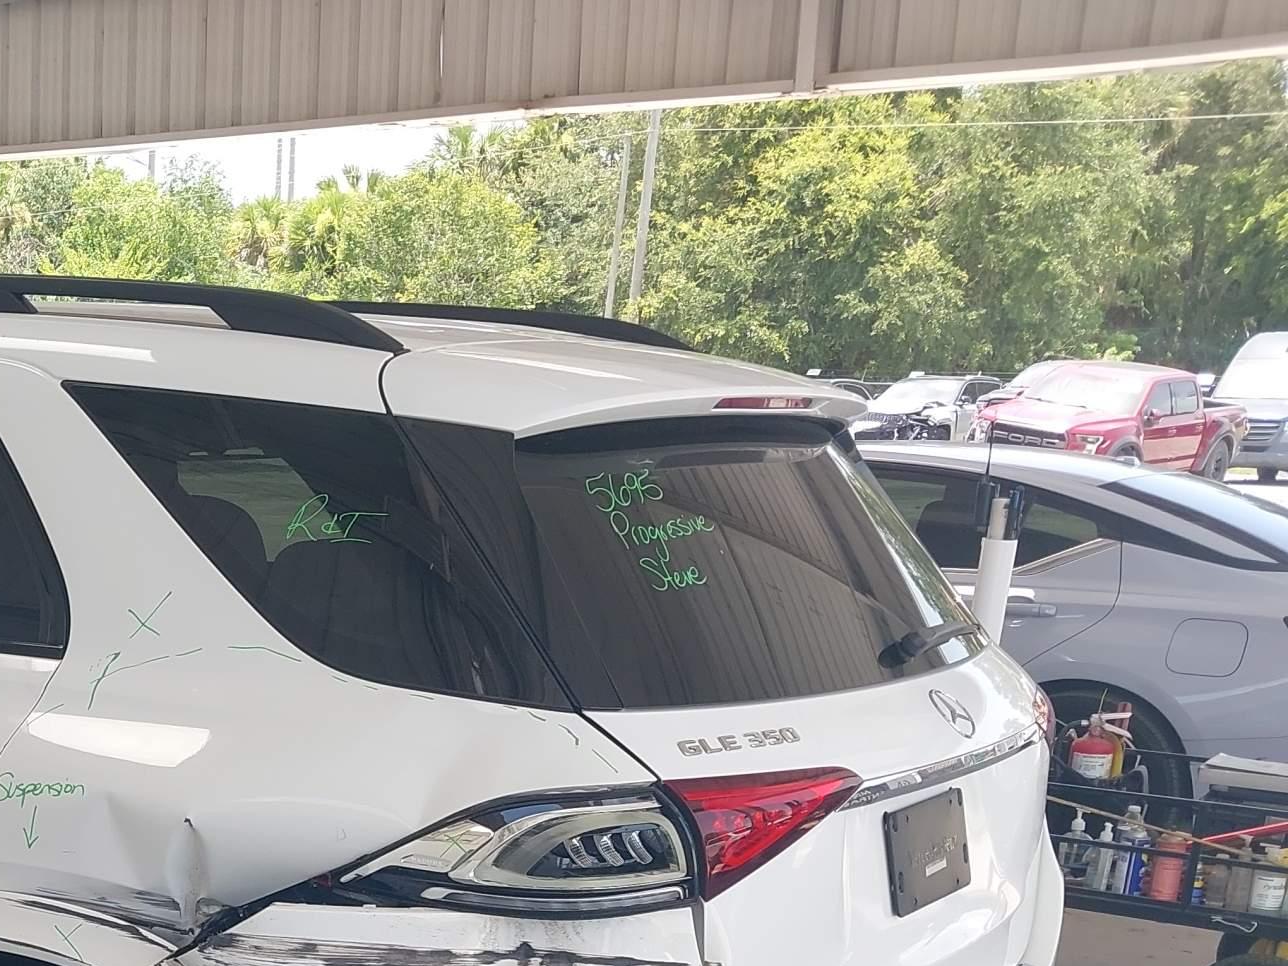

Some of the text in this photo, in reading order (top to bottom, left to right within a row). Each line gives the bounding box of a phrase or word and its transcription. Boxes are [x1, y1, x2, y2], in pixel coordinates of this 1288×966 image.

[992, 430, 1065, 449] FORD
[585, 468, 664, 512] 5695
[610, 510, 715, 562] Progressive
[639, 557, 708, 591] Steve
[676, 726, 801, 757] GLE 350
